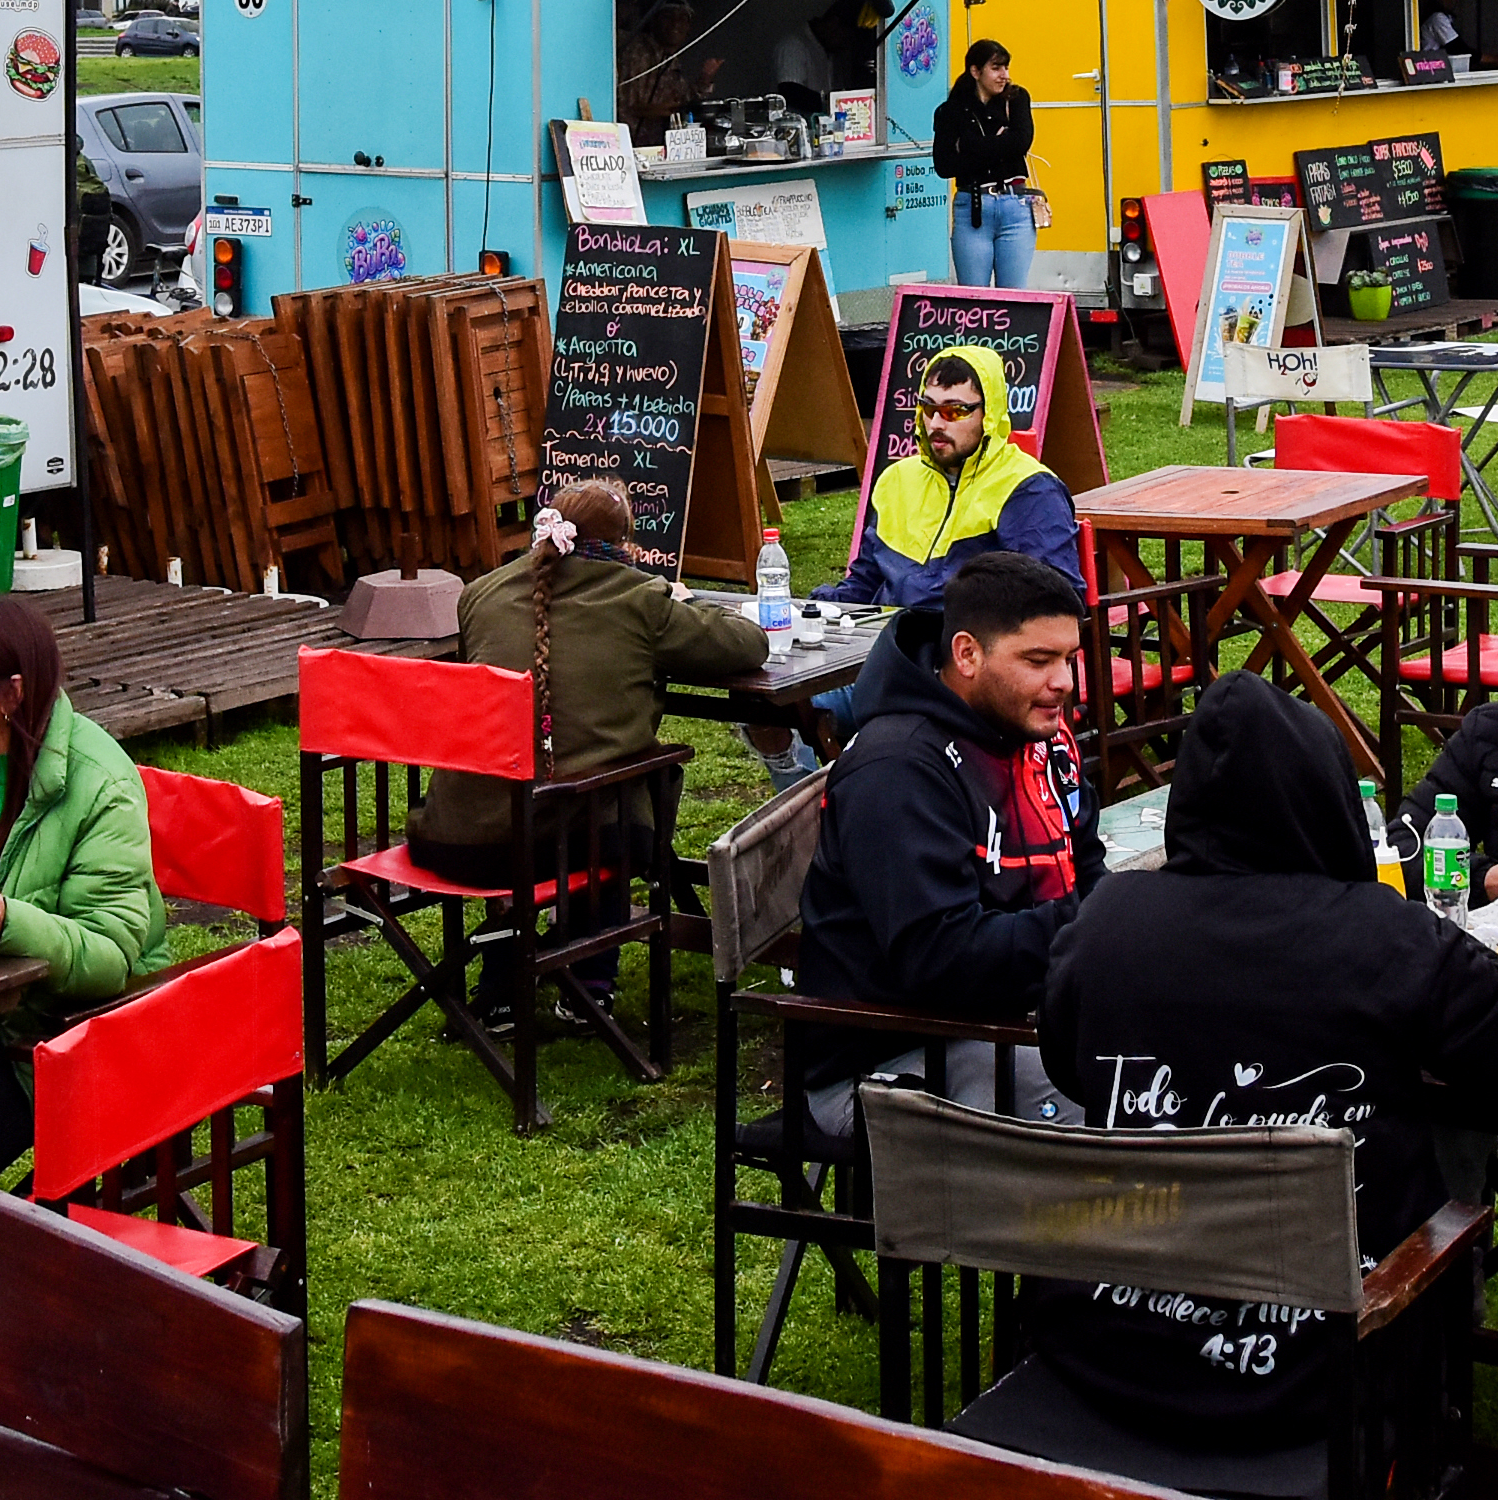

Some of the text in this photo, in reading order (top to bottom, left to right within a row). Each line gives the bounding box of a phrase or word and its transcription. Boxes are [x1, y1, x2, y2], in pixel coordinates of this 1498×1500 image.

[581, 155, 625, 172] HELADO
[677, 236, 701, 257] XL
[1227, 251, 1265, 261] BUBBLE
[1226, 259, 1245, 268] TEA
[914, 299, 1011, 336] Burgers
[607, 409, 680, 442] 15.000
[541, 440, 659, 469] Tremendo XL
[627, 480, 670, 498] casa
[1095, 1054, 1188, 1130] Todo
[1343, 1100, 1376, 1123] en
[1200, 1333, 1278, 1377] 4:13
